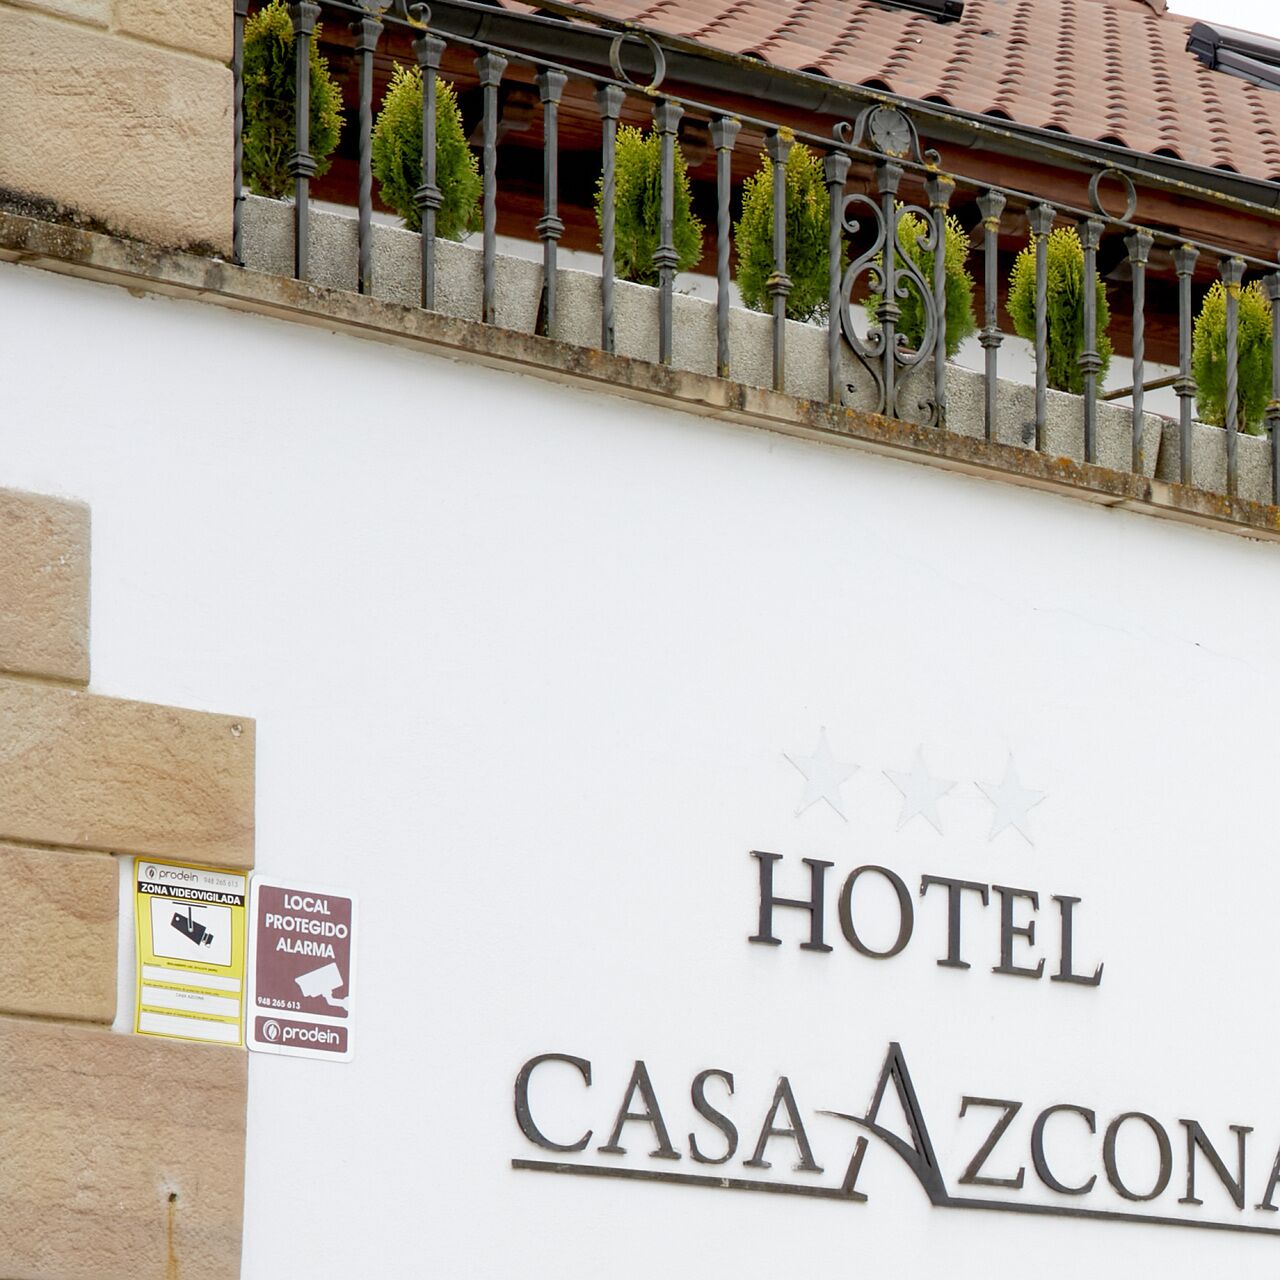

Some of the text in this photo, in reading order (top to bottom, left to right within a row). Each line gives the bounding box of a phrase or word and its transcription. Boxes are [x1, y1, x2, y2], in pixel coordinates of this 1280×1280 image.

[159, 869, 199, 884] prodein
[141, 883, 241, 905] ZONA VIDEOVIGILADA
[284, 894, 331, 915] LOCAL
[265, 913, 348, 939] PROTEGIDO
[749, 850, 1104, 987] HOTEL
[276, 937, 335, 959] ALARMA
[257, 996, 301, 1010] 948 265 613
[282, 1026, 340, 1045] prodein
[513, 1053, 825, 1173] CASA
